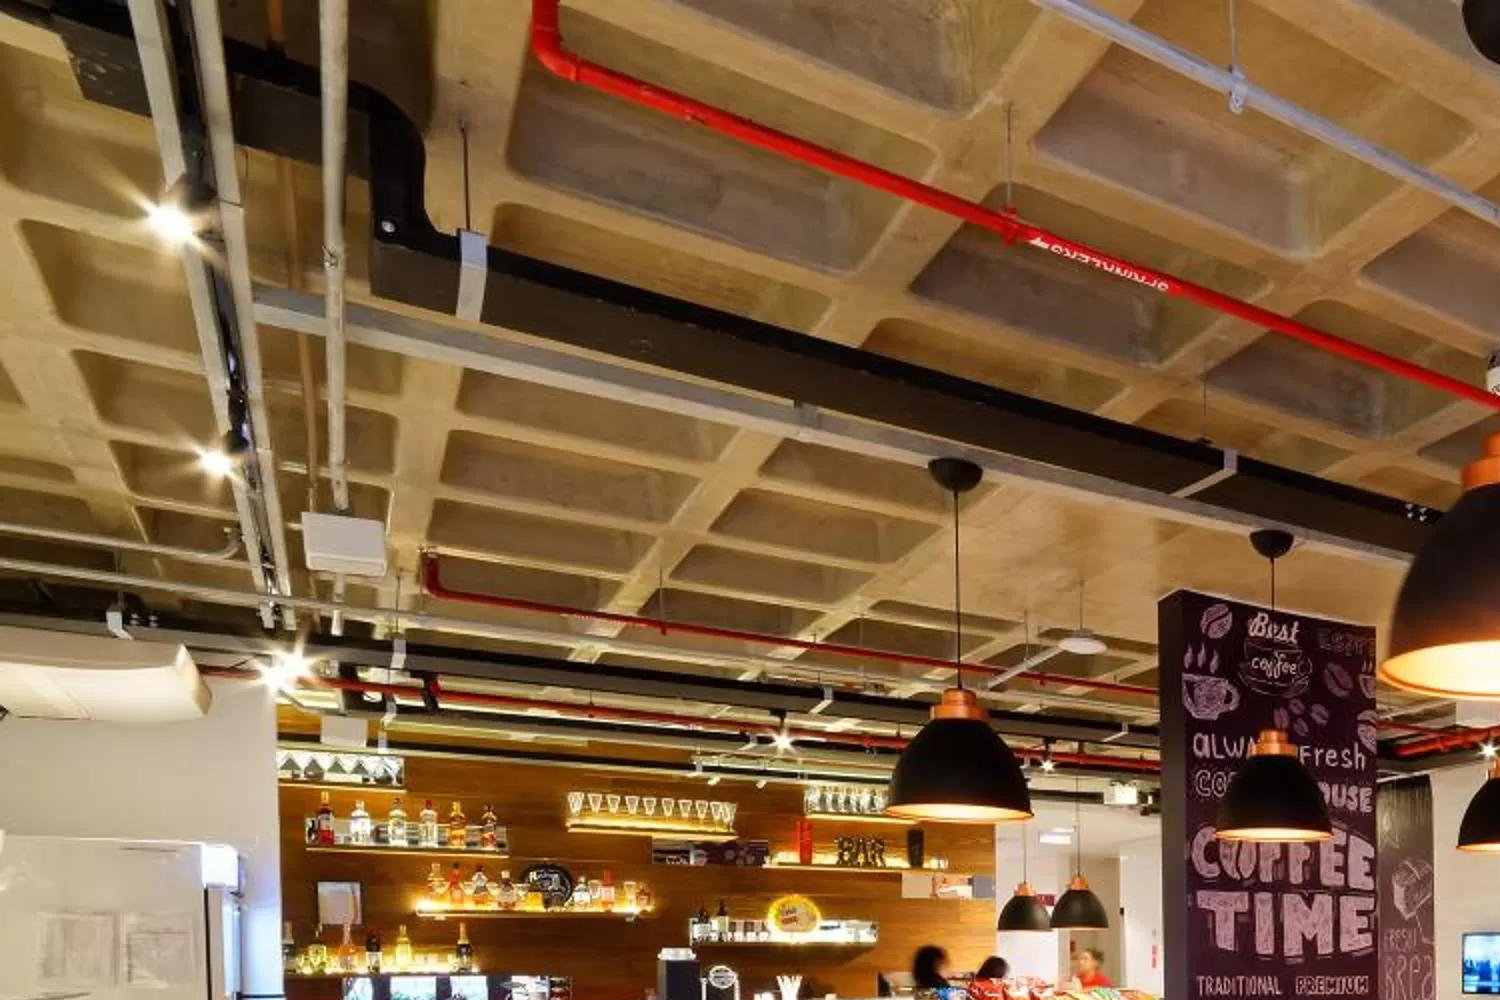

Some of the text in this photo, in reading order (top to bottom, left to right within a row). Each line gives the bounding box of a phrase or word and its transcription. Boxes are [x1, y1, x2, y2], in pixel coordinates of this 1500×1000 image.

[1248, 611, 1300, 643] Best
[1251, 651, 1297, 678] coffee
[1300, 742, 1366, 771] Fresh
[1191, 825, 1375, 890] COFFEE
[1196, 890, 1375, 960] TIME
[1196, 975, 1369, 996] TRADITIONAL PREMIUM
